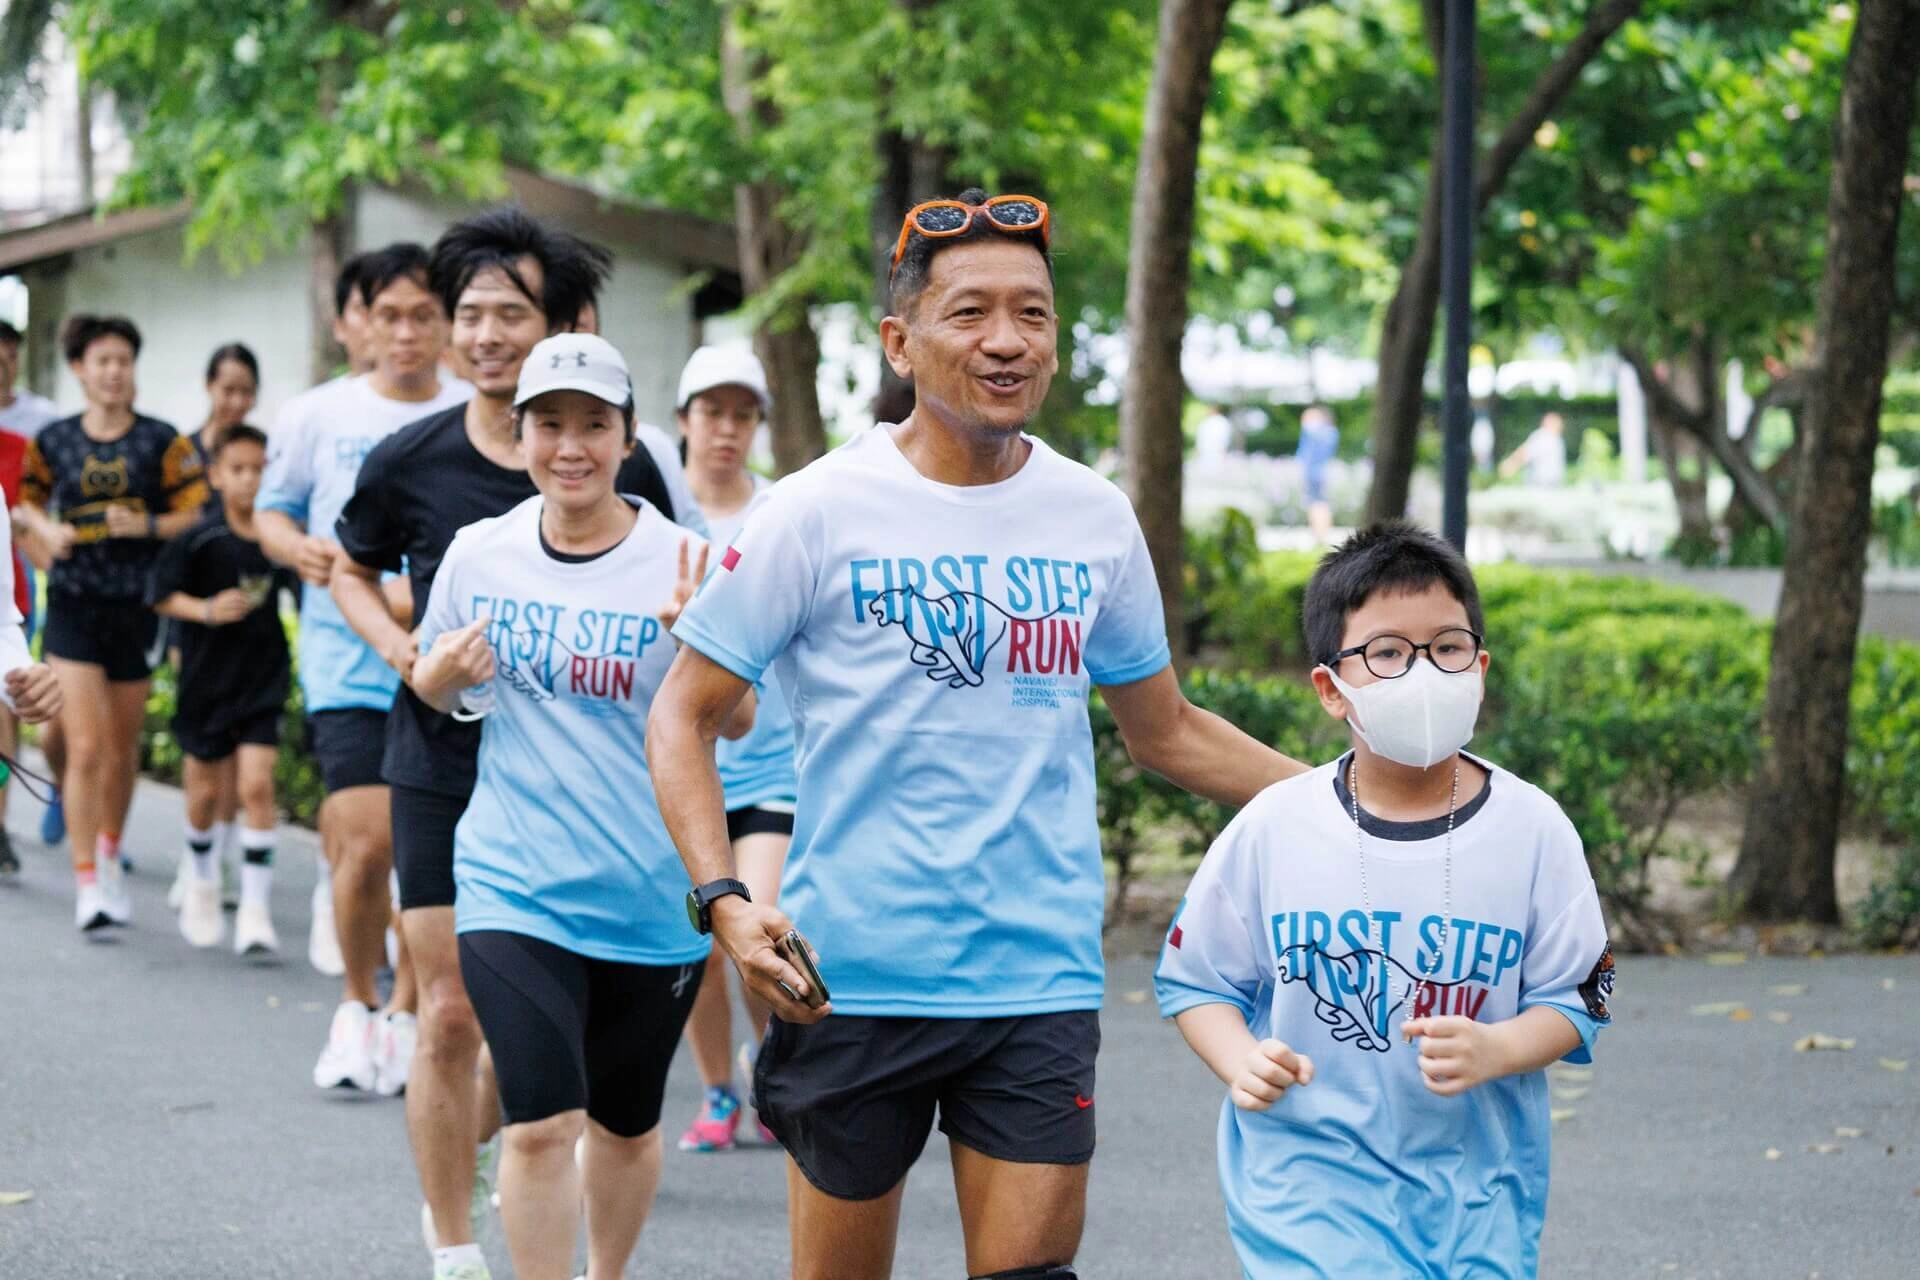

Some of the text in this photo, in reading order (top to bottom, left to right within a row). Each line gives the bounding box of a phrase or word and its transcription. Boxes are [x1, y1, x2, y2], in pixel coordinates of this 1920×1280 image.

[574, 609, 658, 658] STEP
[850, 555, 1092, 674] FIRST STEP
[1007, 618, 1080, 675] RUN
[570, 655, 634, 700] RUN
[1012, 686, 1081, 698] INTERNATIONAL
[1010, 697, 1062, 709] HOSPITAL
[1271, 909, 1523, 1037] FIRST STEP
